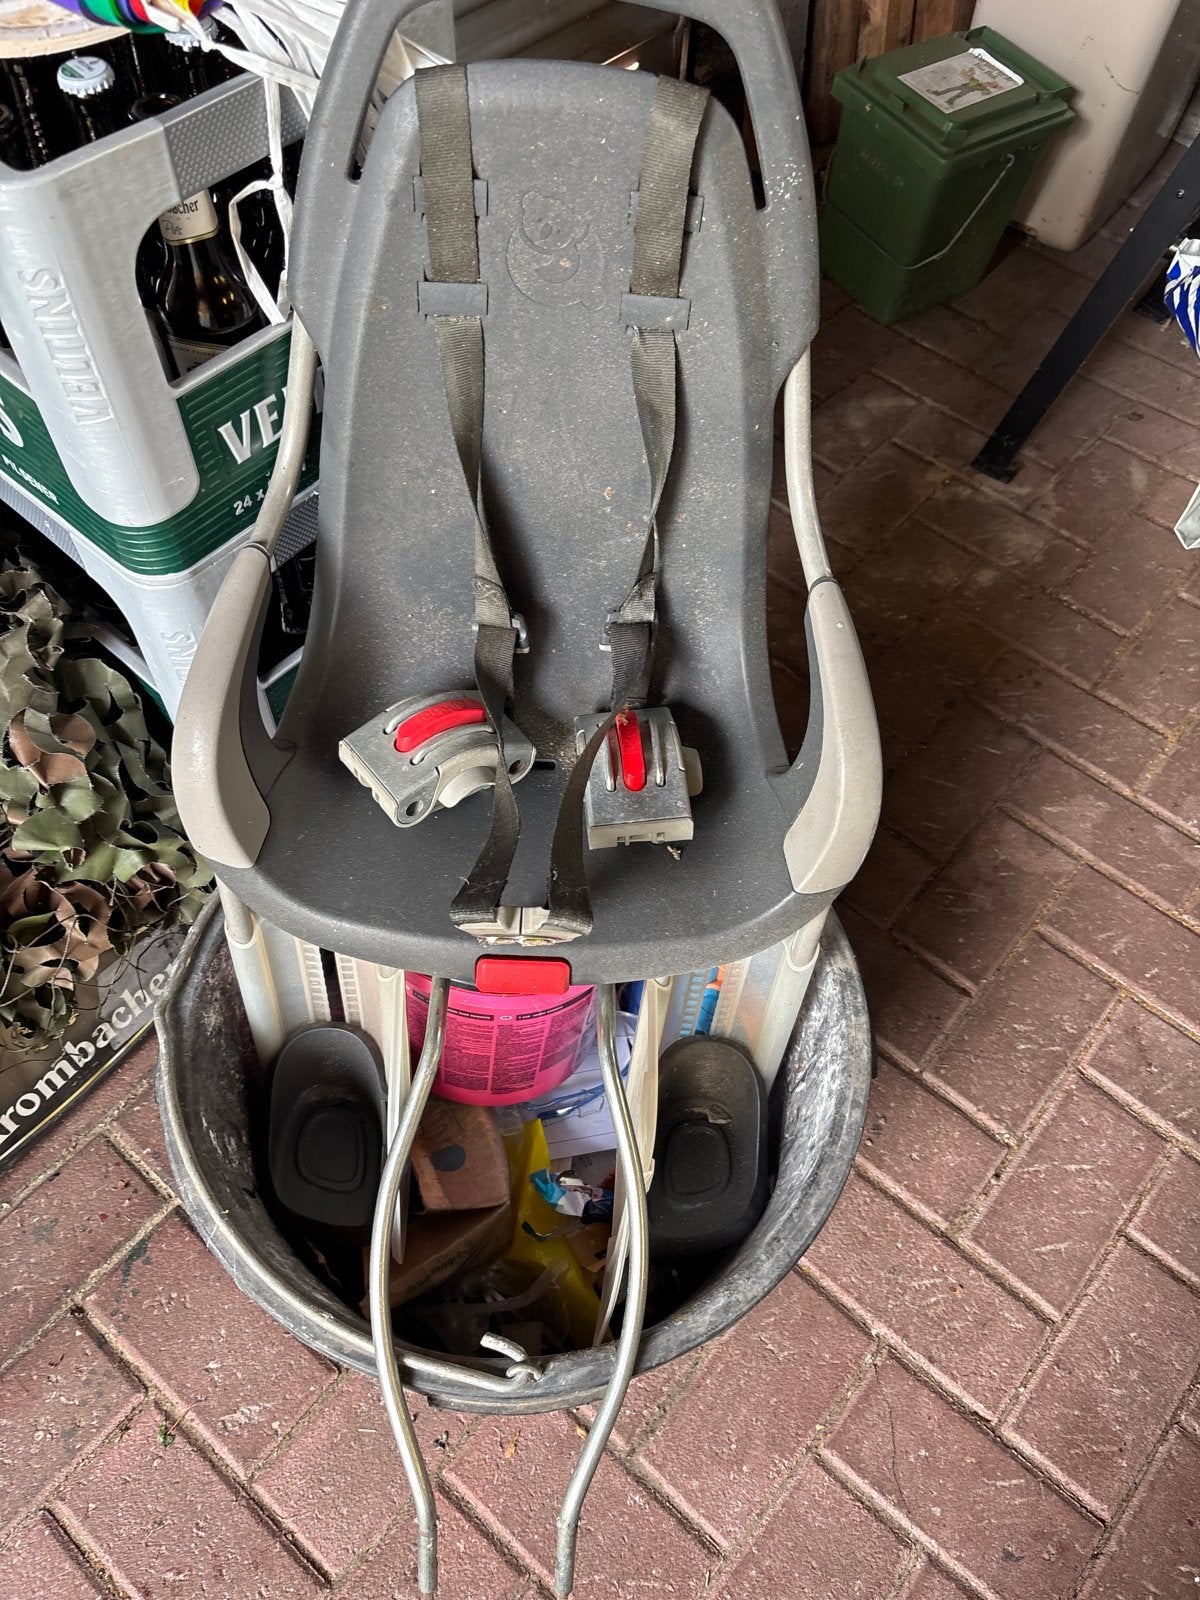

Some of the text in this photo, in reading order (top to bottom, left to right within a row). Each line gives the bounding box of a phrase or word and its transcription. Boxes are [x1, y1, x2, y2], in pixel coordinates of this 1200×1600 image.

[17, 267, 114, 426] VELTINS
[217, 385, 288, 464] VE
[233, 494, 253, 516] 24
[0, 963, 174, 1144] rombache
